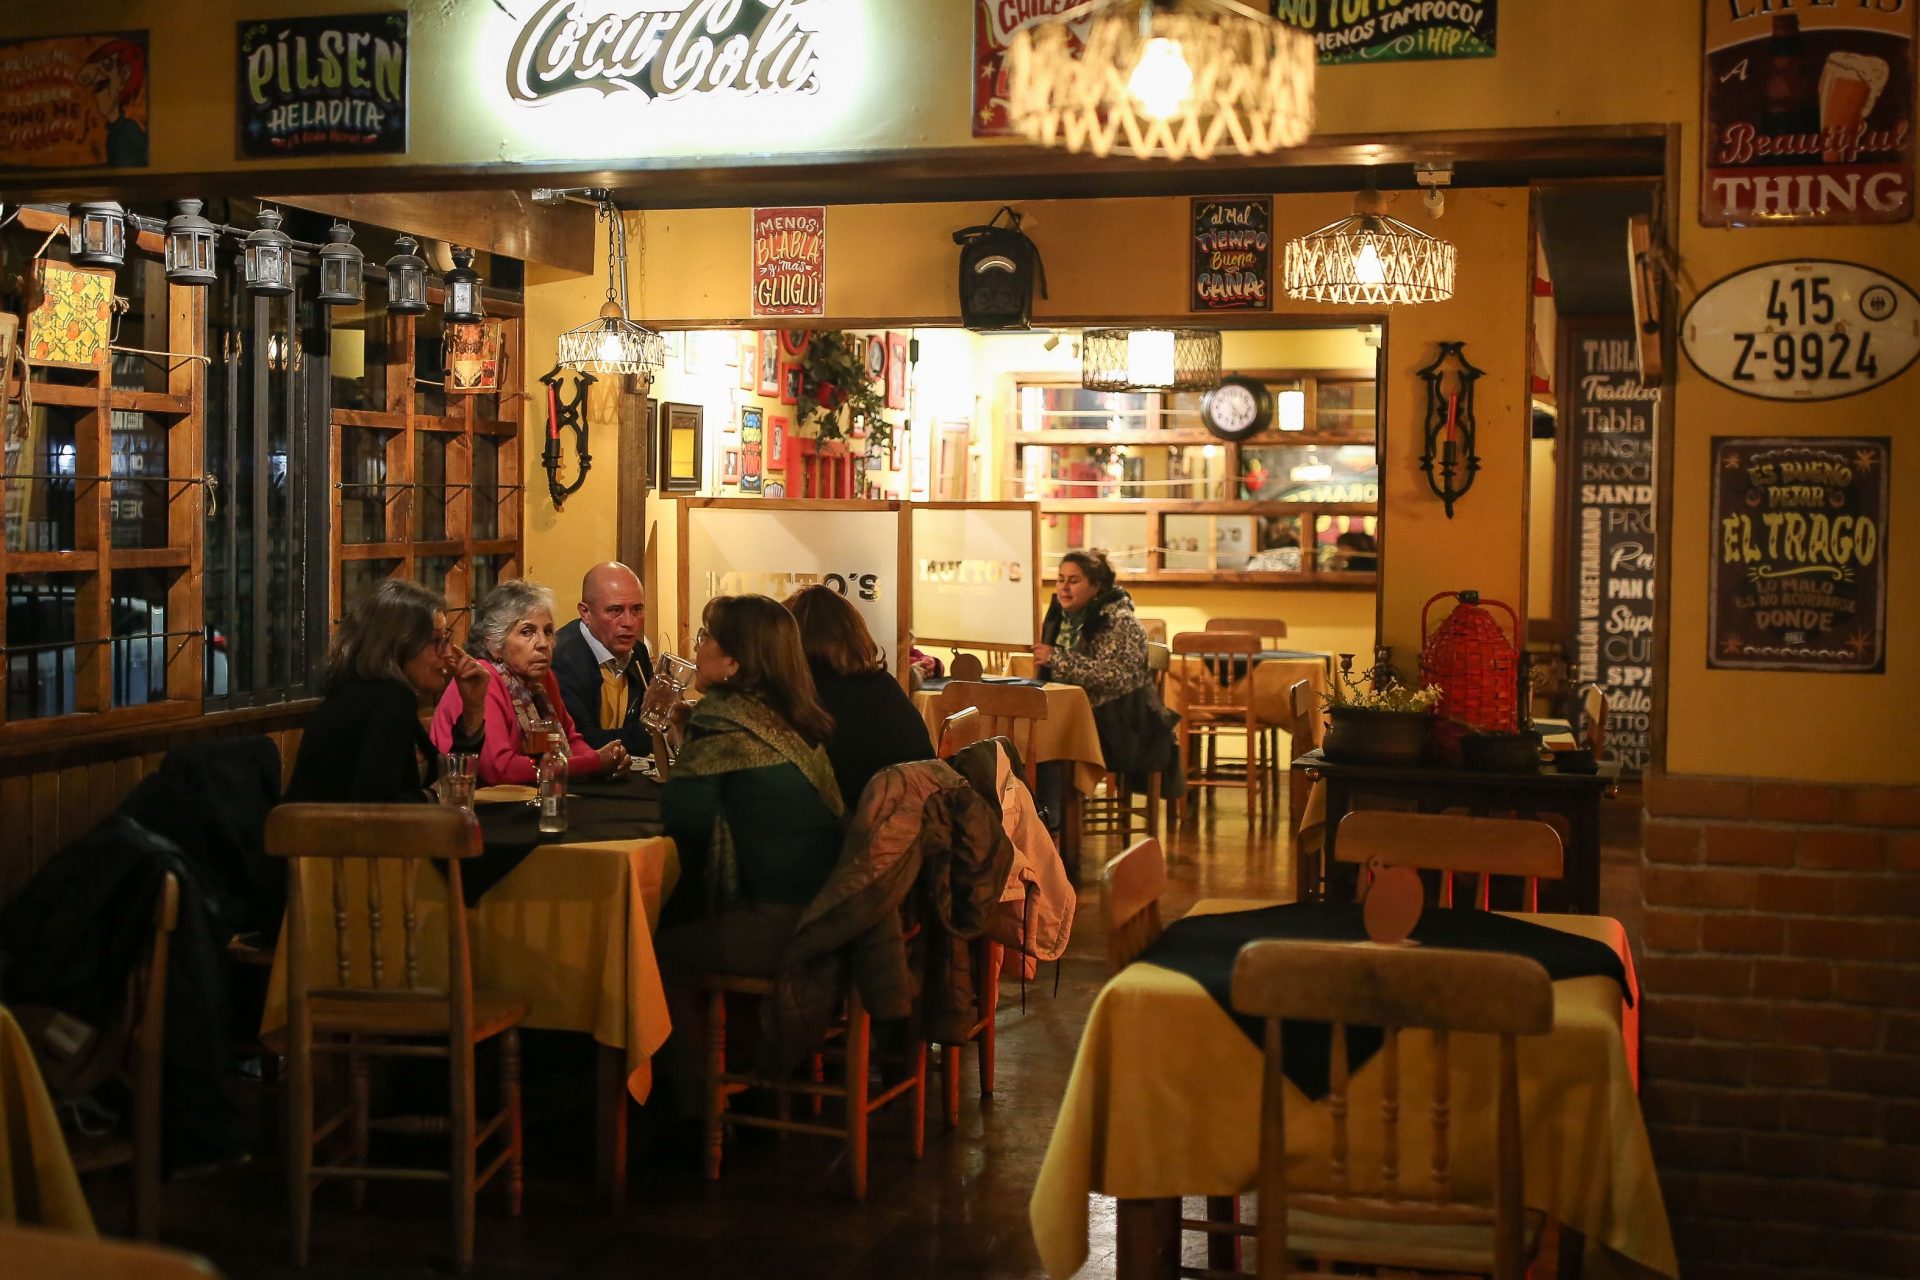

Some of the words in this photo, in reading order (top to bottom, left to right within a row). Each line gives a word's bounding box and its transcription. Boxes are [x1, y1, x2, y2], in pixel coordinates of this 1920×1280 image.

[1379, 1, 1483, 33] TAMPOCO!
[247, 29, 403, 104] PÍLSEN
[505, 0, 820, 107] Coca-Cola
[1720, 59, 1749, 83] A
[52, 99, 81, 122] ME
[267, 98, 385, 131] HELADITA
[1719, 119, 1910, 164] Beautiful
[1712, 172, 1907, 215] THING
[760, 217, 817, 235] MENOS
[756, 230, 823, 266] BLABLÁ
[1211, 251, 1256, 271] Buena
[768, 264, 777, 278] y
[758, 271, 818, 306] GLUGLÚ
[1766, 277, 1834, 325] 415
[1733, 332, 1878, 381] Z-9924
[1581, 407, 1646, 433] Tabla
[1779, 460, 1853, 487] BUENO
[1581, 484, 1653, 504] SAND
[1722, 513, 1762, 564] EL
[1762, 511, 1877, 567] TRAGO
[1608, 578, 1644, 599] PAN
[1781, 578, 1835, 595] MALO
[1755, 608, 1834, 632] DONDE
